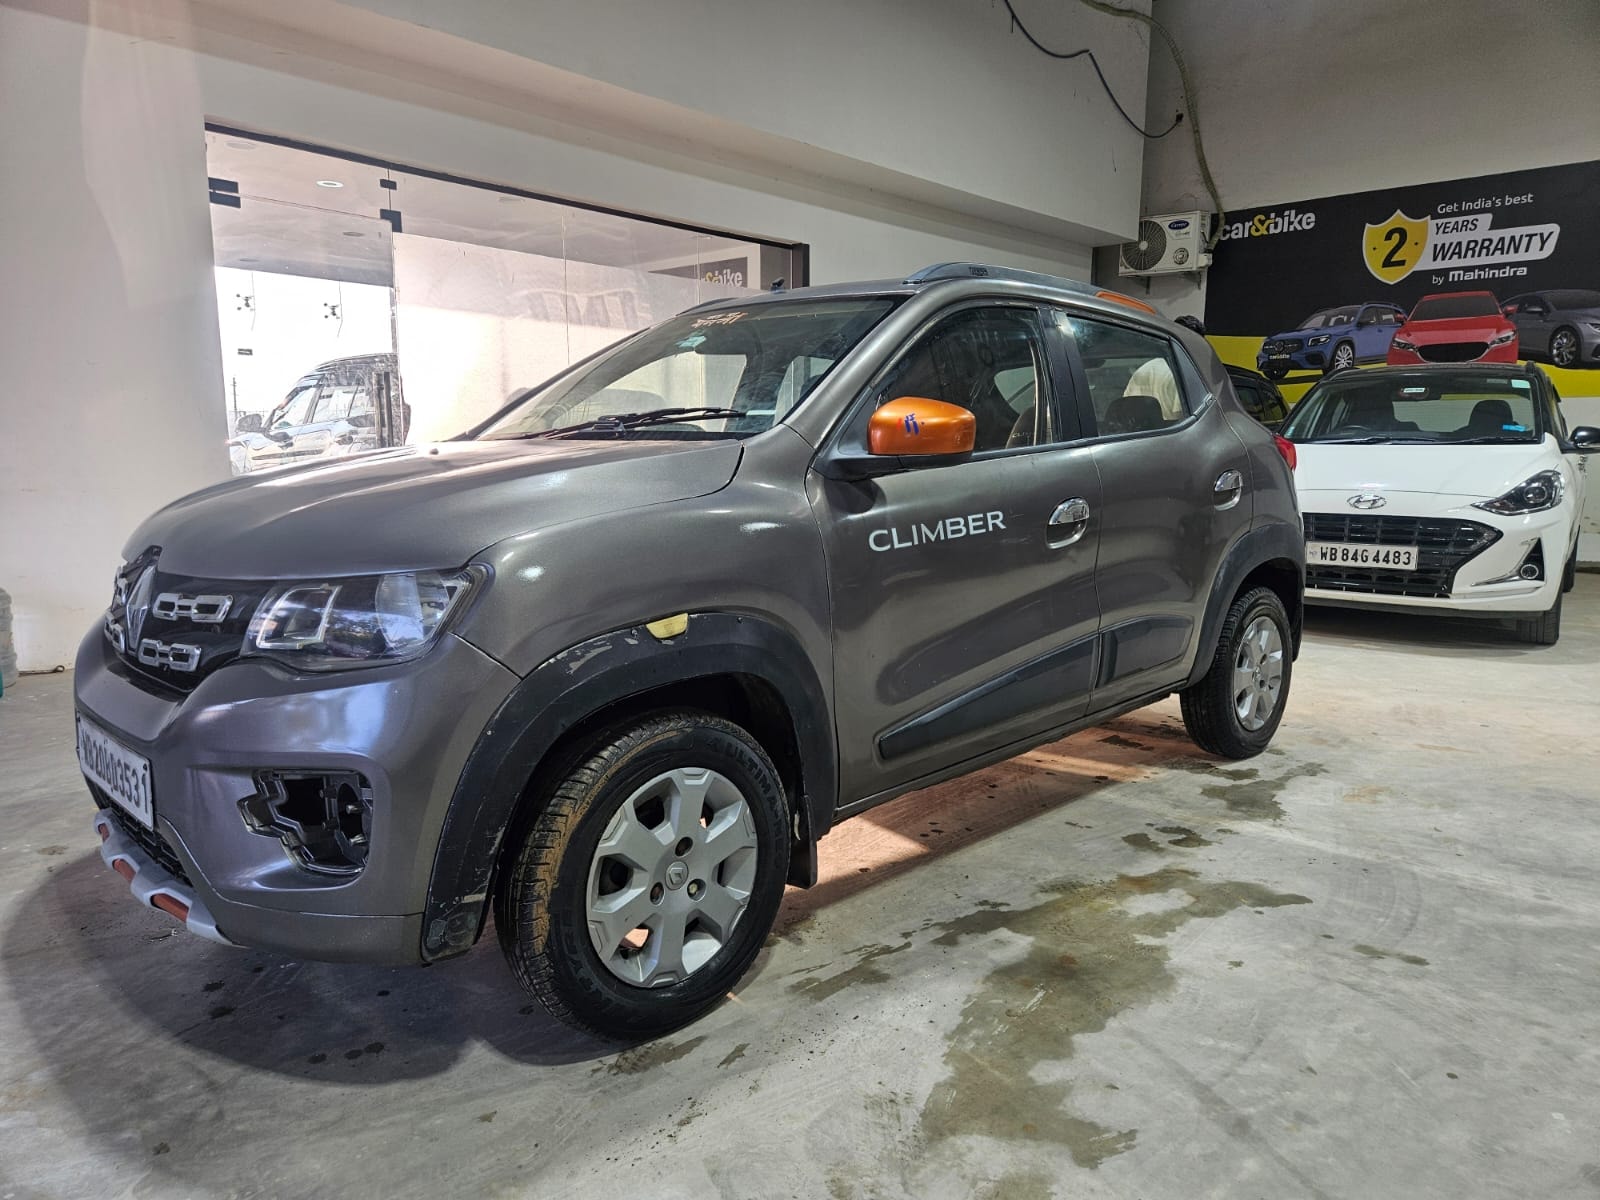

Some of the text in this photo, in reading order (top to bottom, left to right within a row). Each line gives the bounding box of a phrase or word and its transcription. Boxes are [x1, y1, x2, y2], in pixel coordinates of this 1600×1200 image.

[1437, 192, 1534, 214] Get India's best
[1219, 209, 1316, 241] car&bike
[1381, 218, 1479, 269] 2 YEARS
[1431, 231, 1554, 262] WARRANTY
[1431, 266, 1528, 286] by Mahindra
[868, 510, 1006, 552] CLIMBER
